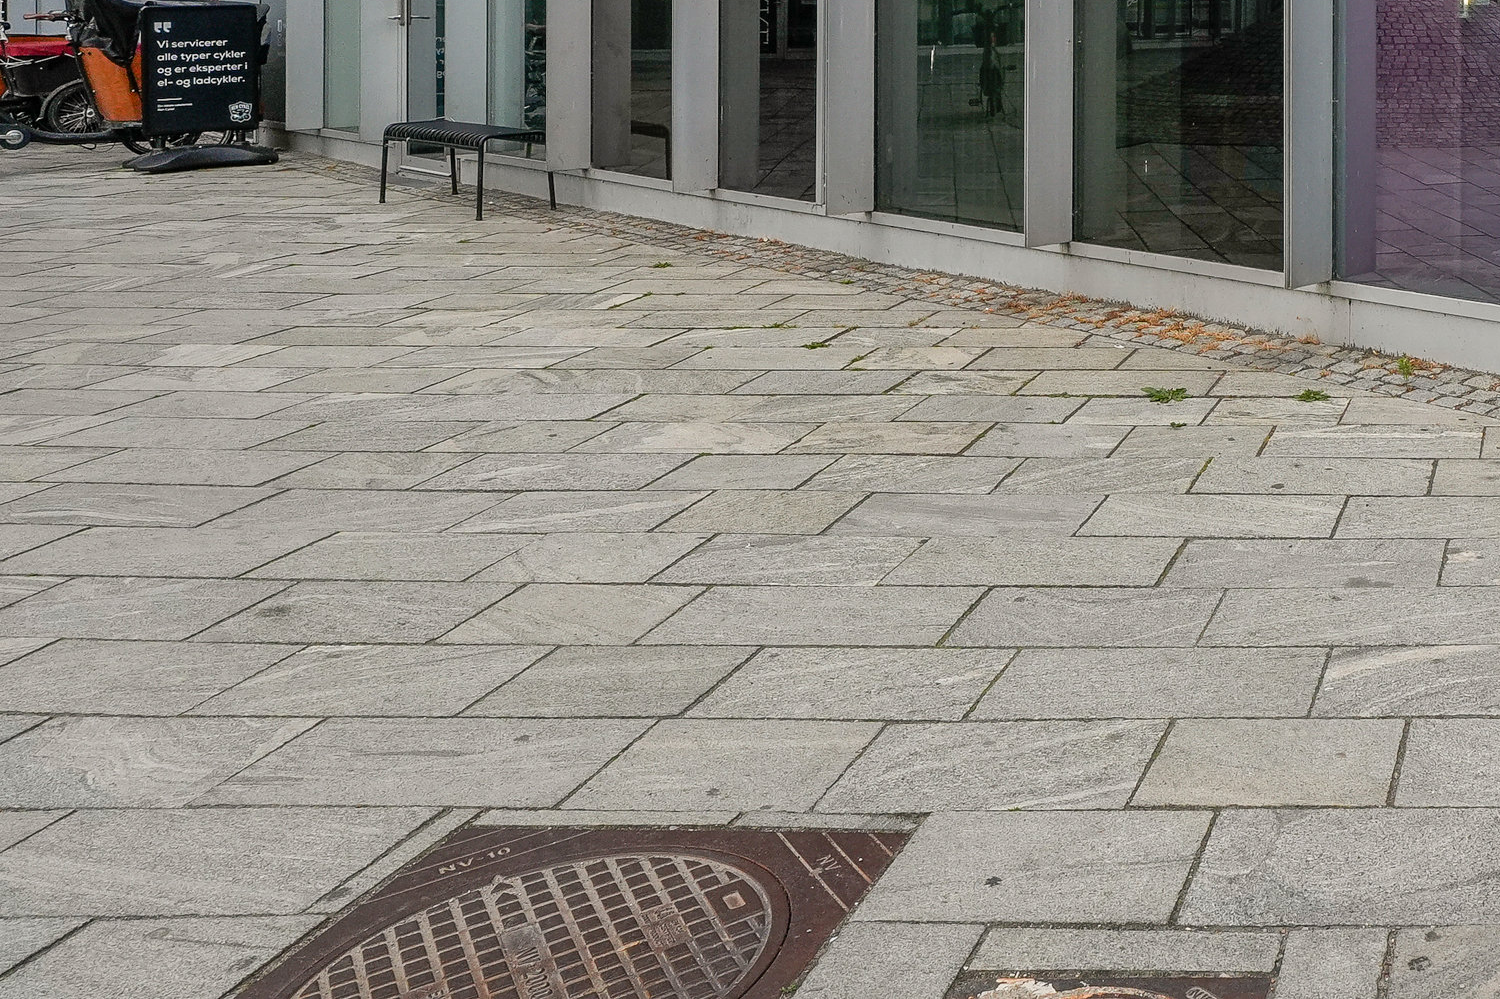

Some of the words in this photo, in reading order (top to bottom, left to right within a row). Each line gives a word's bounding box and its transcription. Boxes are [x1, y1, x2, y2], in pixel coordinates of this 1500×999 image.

[156, 40, 169, 49] Vi
[171, 39, 228, 48] servicerer
[157, 53, 178, 61] alle
[180, 52, 211, 62] typer
[213, 50, 246, 60] cykler
[157, 67, 172, 76] og
[174, 66, 187, 74] er
[189, 63, 243, 74] eksperter
[157, 78, 174, 87] el-
[176, 79, 191, 88] og
[193, 75, 246, 86] ladcykler.
